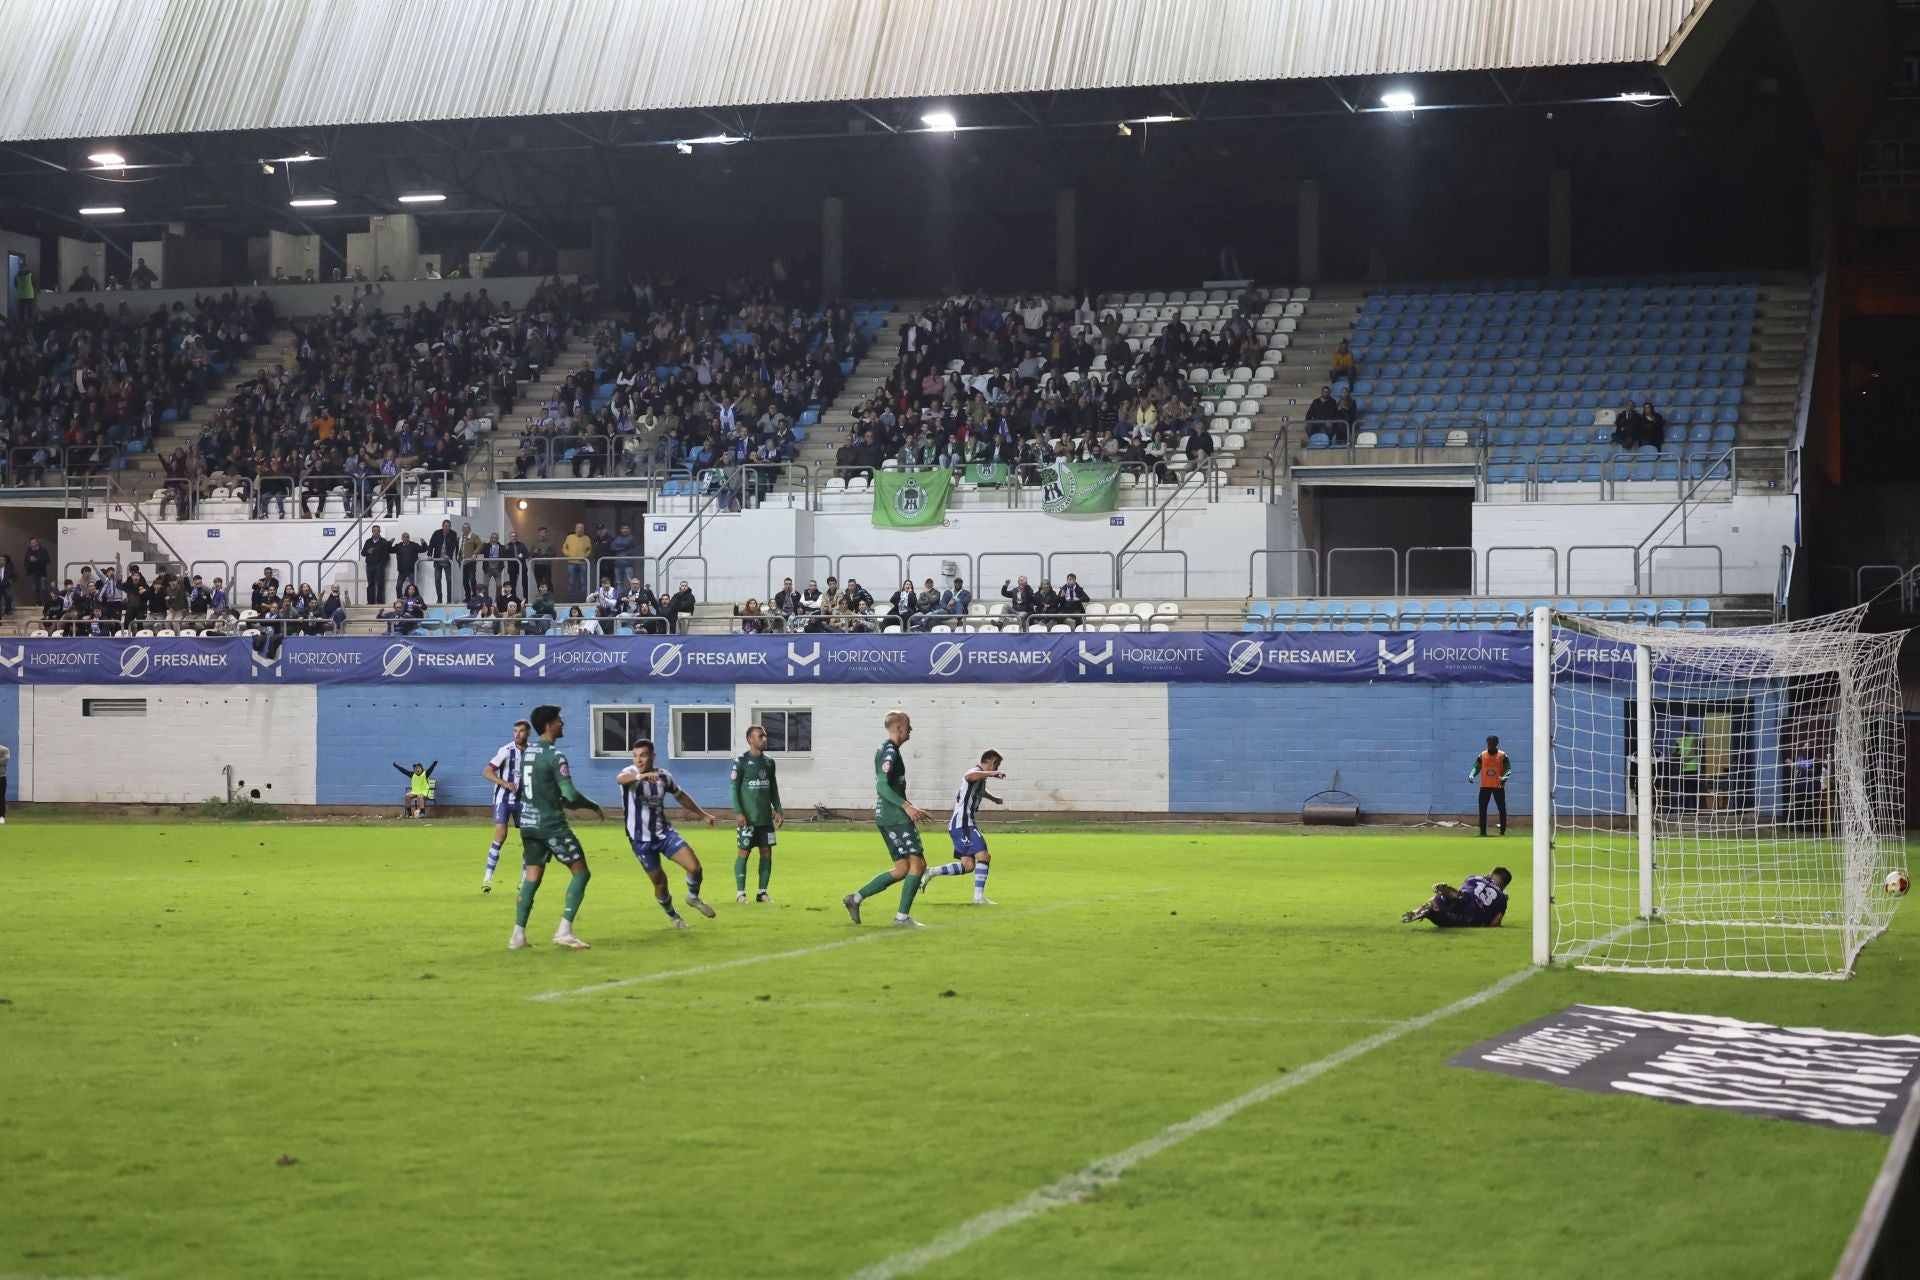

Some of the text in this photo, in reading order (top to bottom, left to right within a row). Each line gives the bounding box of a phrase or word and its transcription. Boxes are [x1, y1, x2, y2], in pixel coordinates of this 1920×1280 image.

[31, 653, 100, 665] HORIZONTE
[153, 653, 228, 667] FRESAMEX
[288, 652, 362, 665] HORIZONTE
[418, 653, 495, 667] FRESAMEX
[553, 651, 628, 664] HORIZONTE
[687, 652, 767, 666] FRESAMEX
[828, 650, 907, 663] HORIZONTE
[968, 650, 1052, 664] FRESAMEX
[1121, 648, 1204, 662] HORIZONTE
[1268, 649, 1357, 664] FRESAMEX
[1423, 647, 1510, 661] HORIZONTE
[523, 765, 533, 800] 5
[1474, 881, 1498, 906] 13
